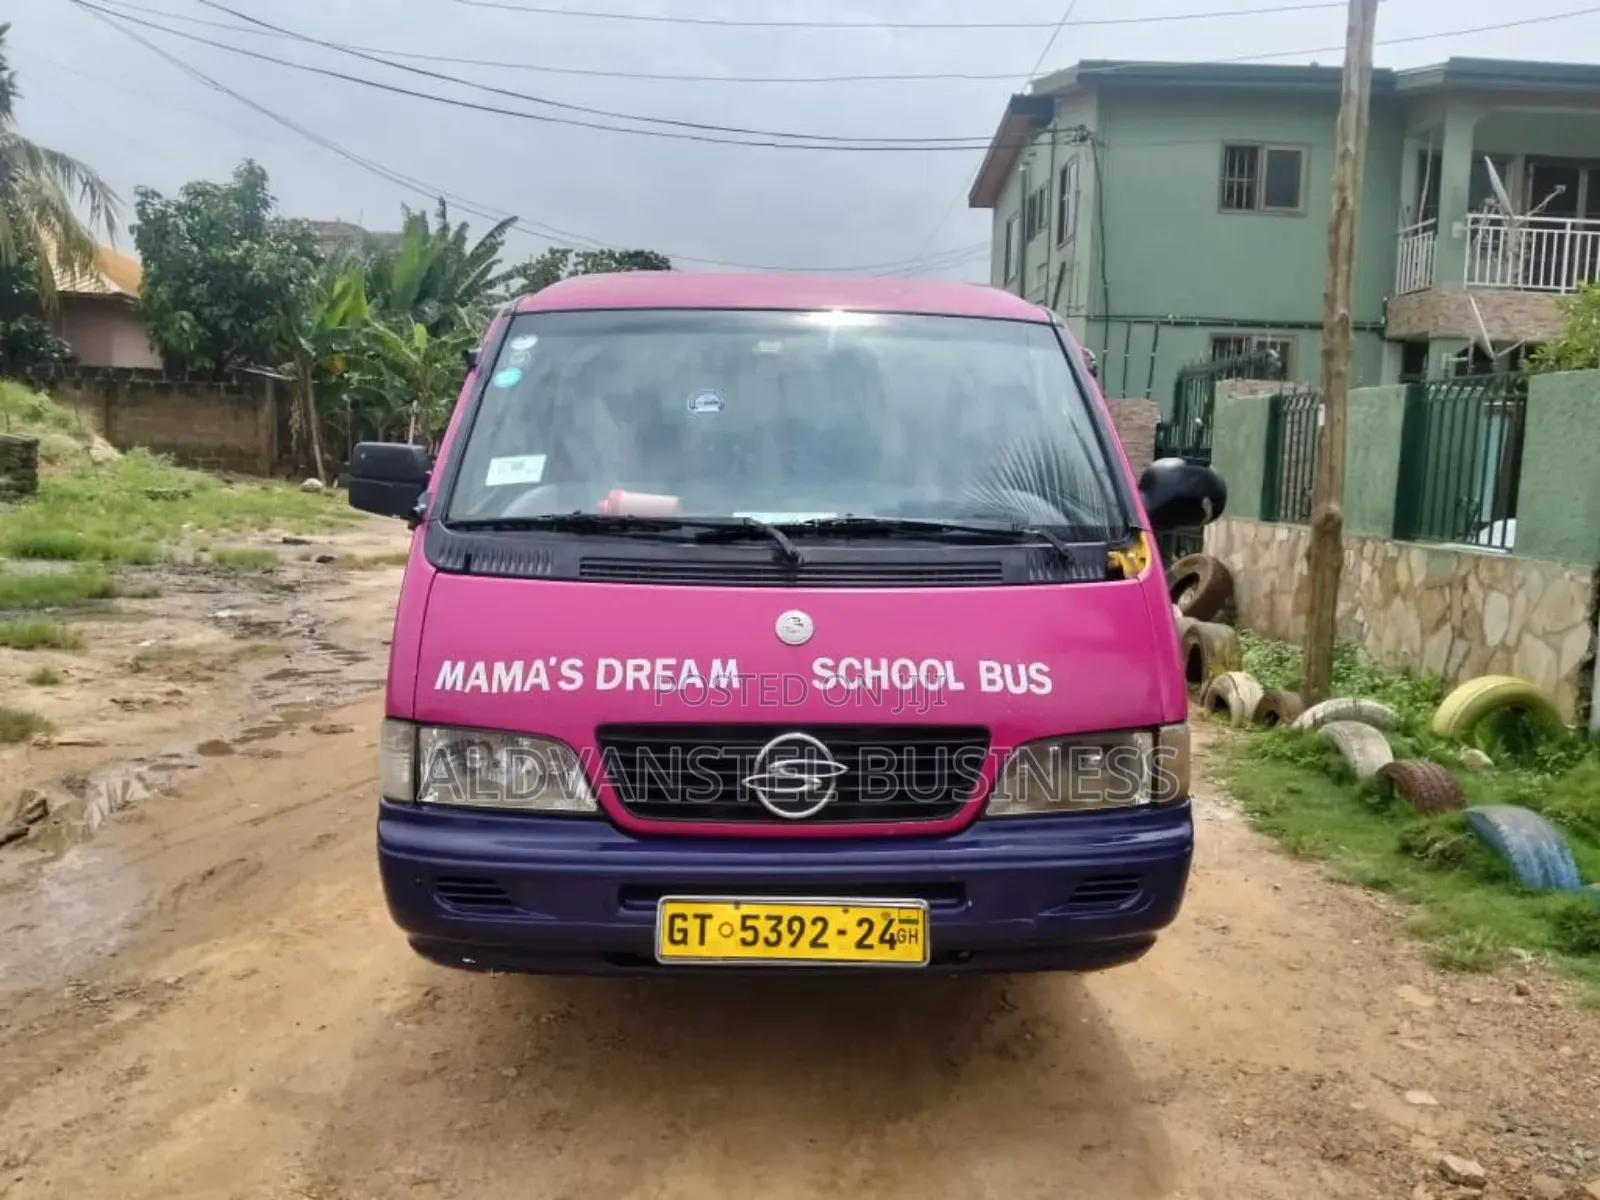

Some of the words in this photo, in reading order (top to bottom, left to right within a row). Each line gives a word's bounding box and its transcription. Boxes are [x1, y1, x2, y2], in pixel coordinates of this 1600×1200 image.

[434, 656, 584, 693] MAMA'S
[596, 657, 741, 691] DREAM
[812, 657, 965, 691] SCHOOL
[979, 660, 1053, 695] BUS
[667, 913, 713, 946] GT
[896, 927, 919, 945] GH
